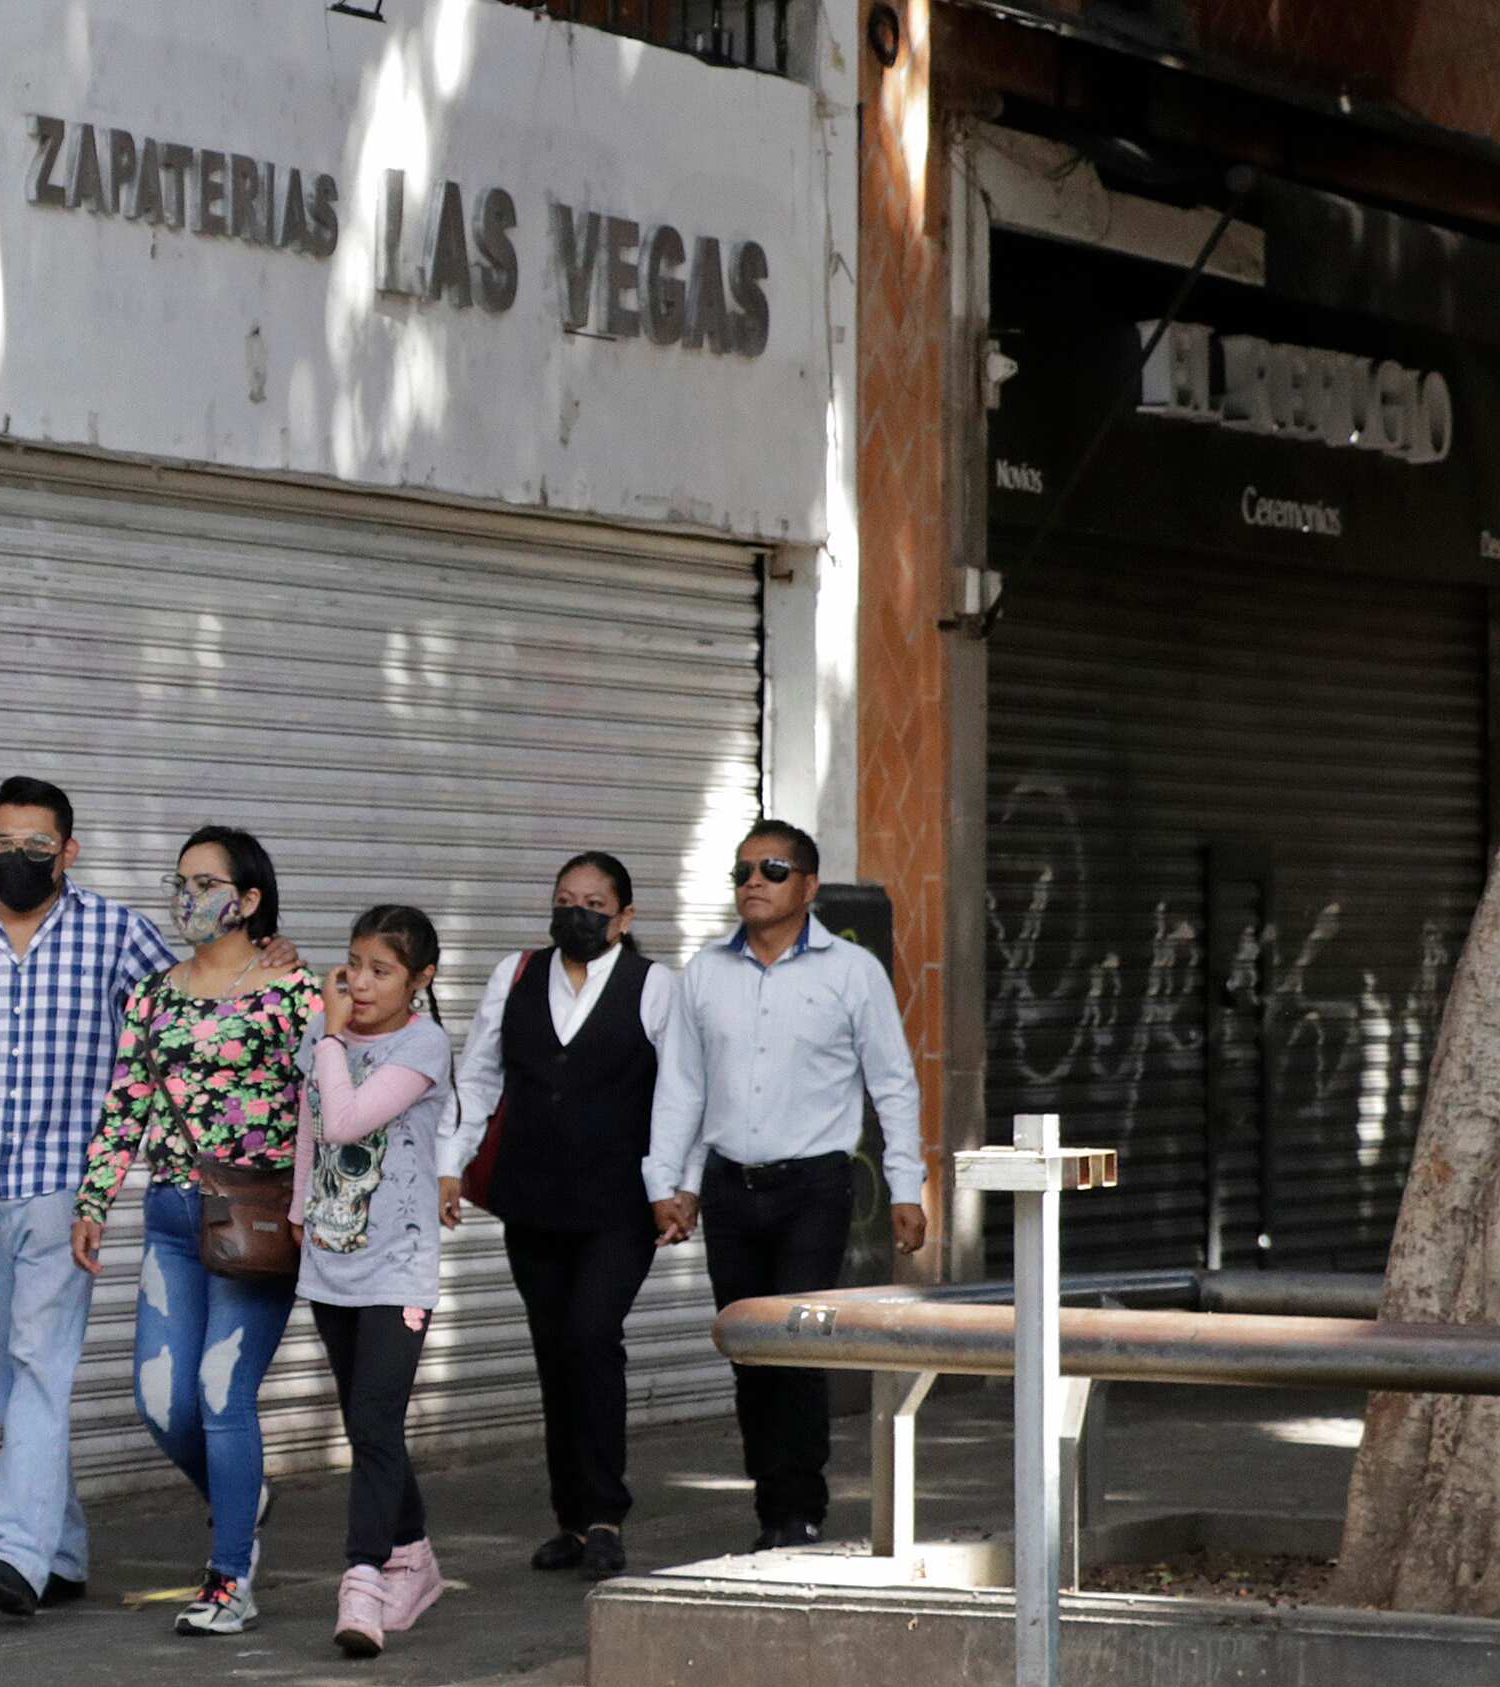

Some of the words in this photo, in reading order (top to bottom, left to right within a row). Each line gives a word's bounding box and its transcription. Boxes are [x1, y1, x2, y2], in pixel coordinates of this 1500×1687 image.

[25, 114, 339, 258] ZAPATERIAS
[375, 168, 518, 314] LAS
[548, 202, 770, 358] VEGAS
